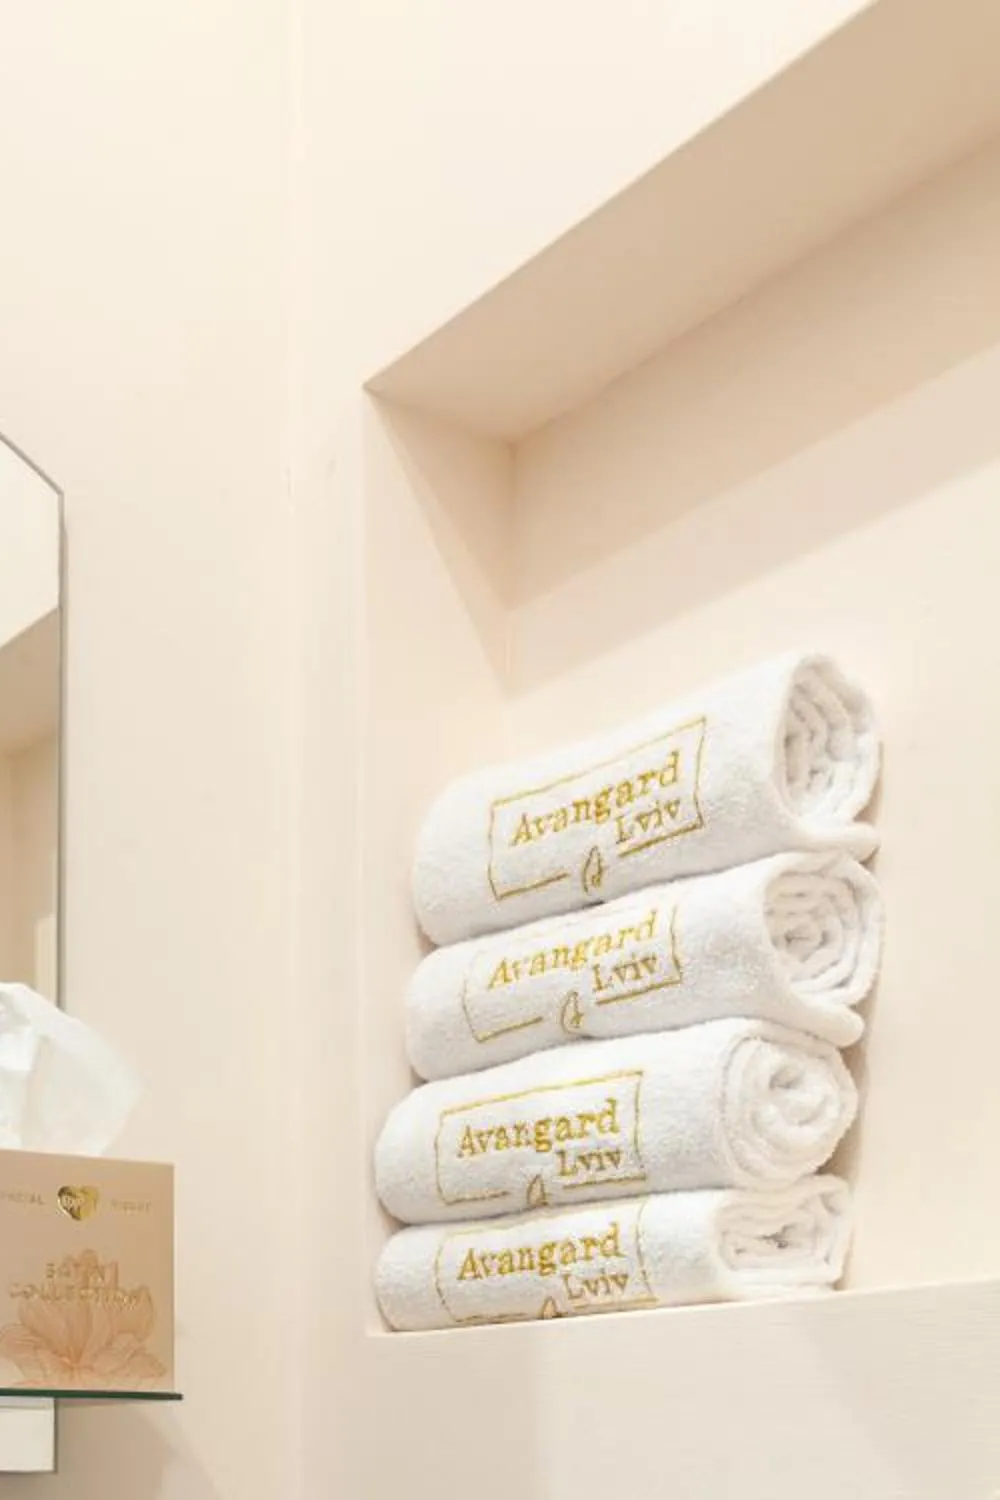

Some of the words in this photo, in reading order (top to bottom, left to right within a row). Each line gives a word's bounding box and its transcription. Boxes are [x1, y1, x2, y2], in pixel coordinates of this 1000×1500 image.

[511, 749, 679, 846] Avangard
[616, 798, 680, 845] Lviv
[488, 910, 657, 990] Avangard
[591, 951, 658, 992] Lviv
[456, 1098, 621, 1159] Avangard
[555, 1145, 622, 1177] Lviv
[457, 1221, 626, 1281] Avangard
[561, 1267, 630, 1300] Lviv
